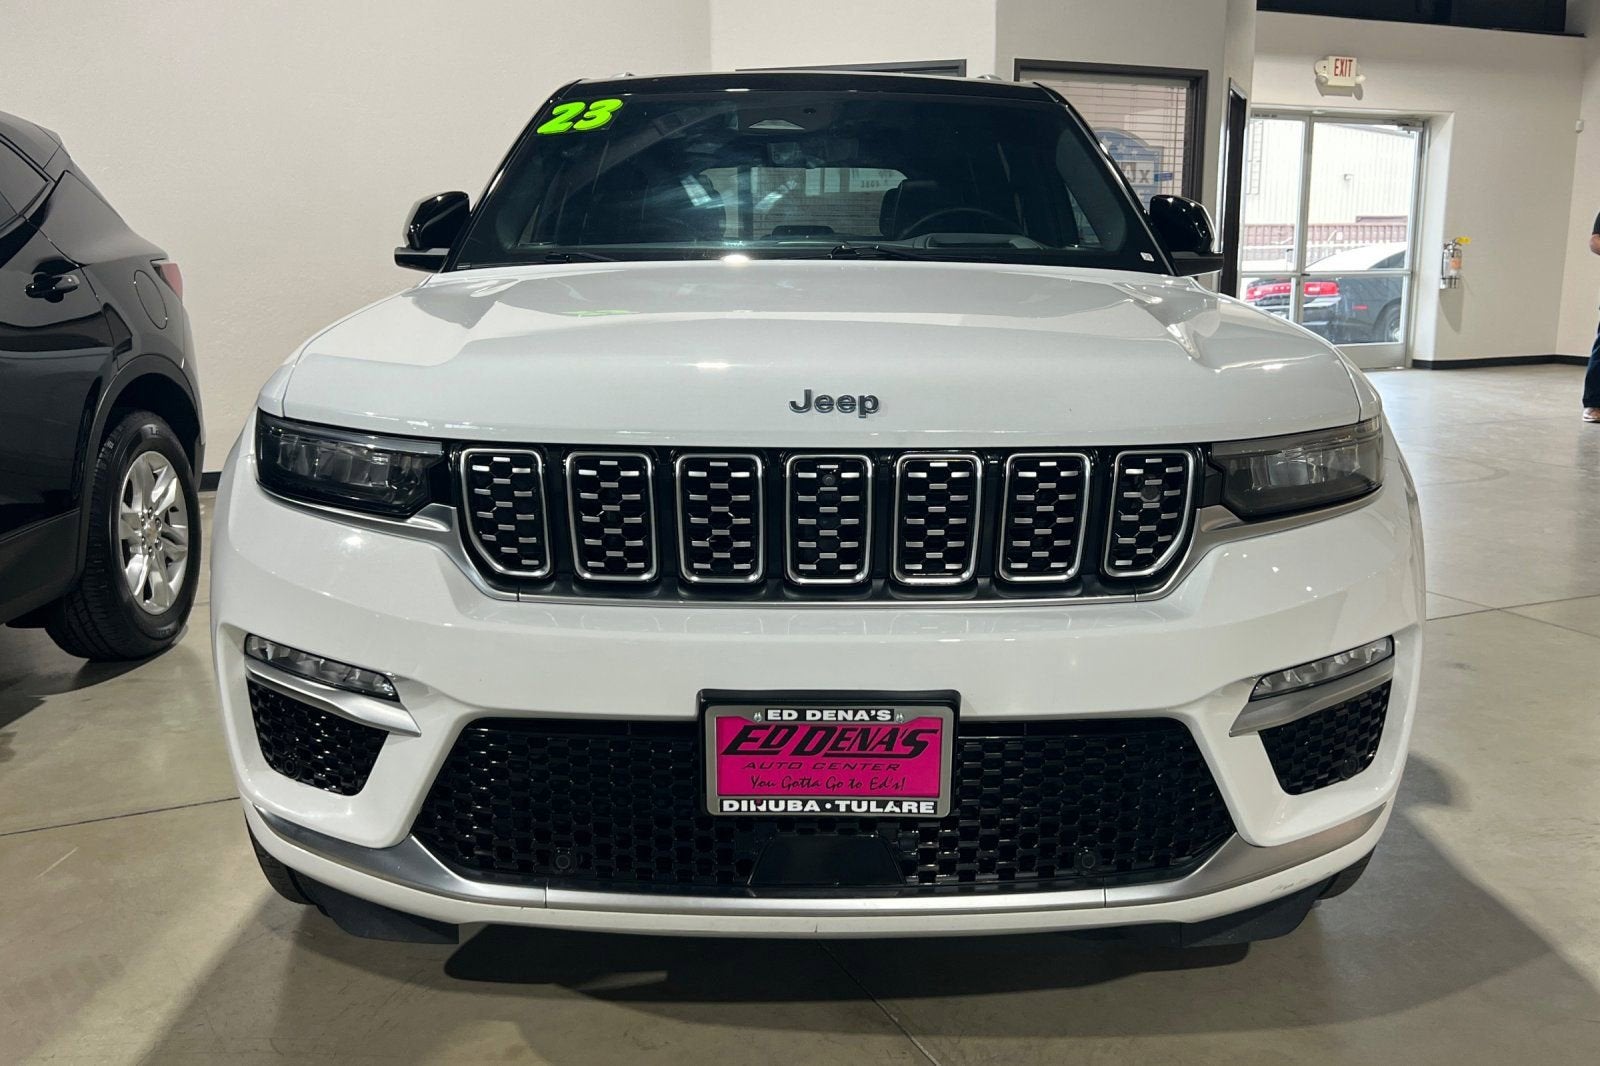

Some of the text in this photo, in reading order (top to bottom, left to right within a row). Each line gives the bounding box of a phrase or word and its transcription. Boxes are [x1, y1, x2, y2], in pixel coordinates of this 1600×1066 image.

[1334, 58, 1353, 77] EXIT
[537, 98, 623, 134] 23
[789, 389, 879, 418] Jeep
[767, 709, 892, 721] ED DENA'S
[721, 725, 940, 759] ED DENA'S
[743, 761, 901, 771] AUTO CENTER
[750, 776, 906, 790] You Gotta Go to Ed's!
[722, 800, 935, 814] DINUBA TULARE
